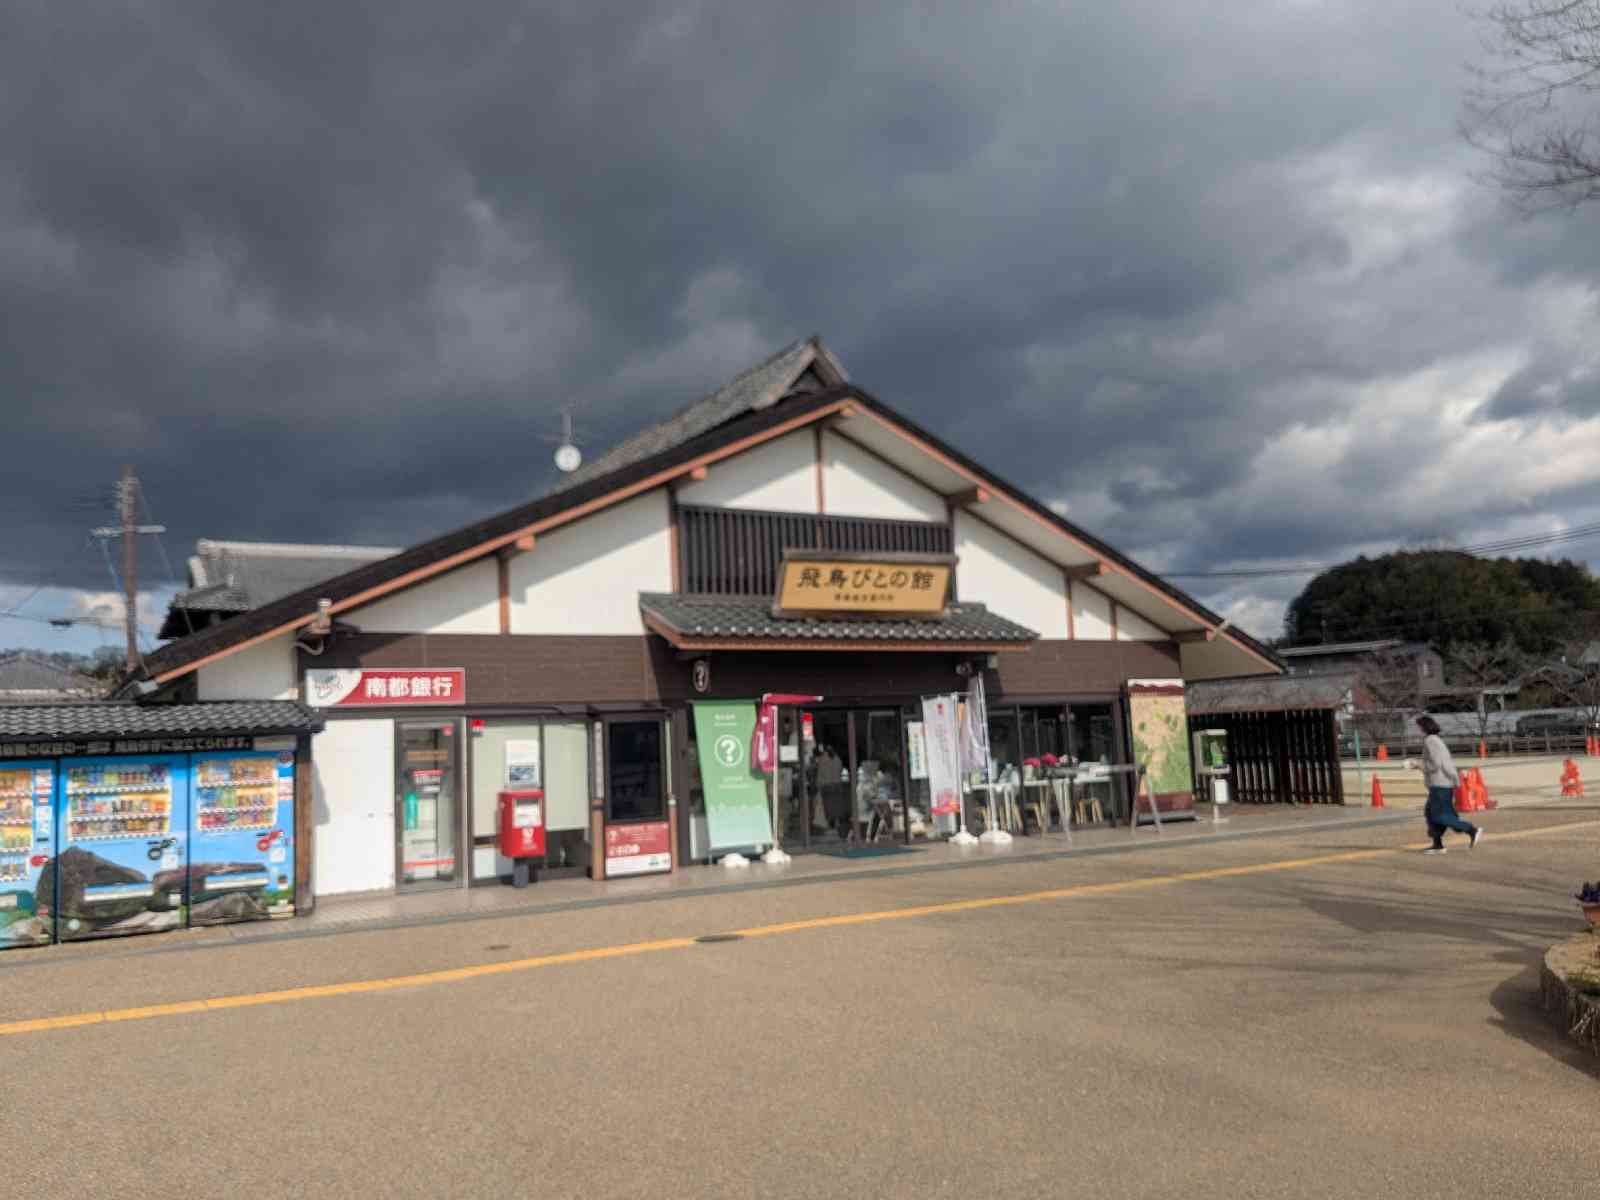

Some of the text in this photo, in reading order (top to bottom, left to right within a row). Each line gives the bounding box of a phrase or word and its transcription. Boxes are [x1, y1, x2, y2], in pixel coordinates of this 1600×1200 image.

[797, 567, 934, 591] 飛鳥びとの館
[366, 676, 453, 698] 南都銀行
